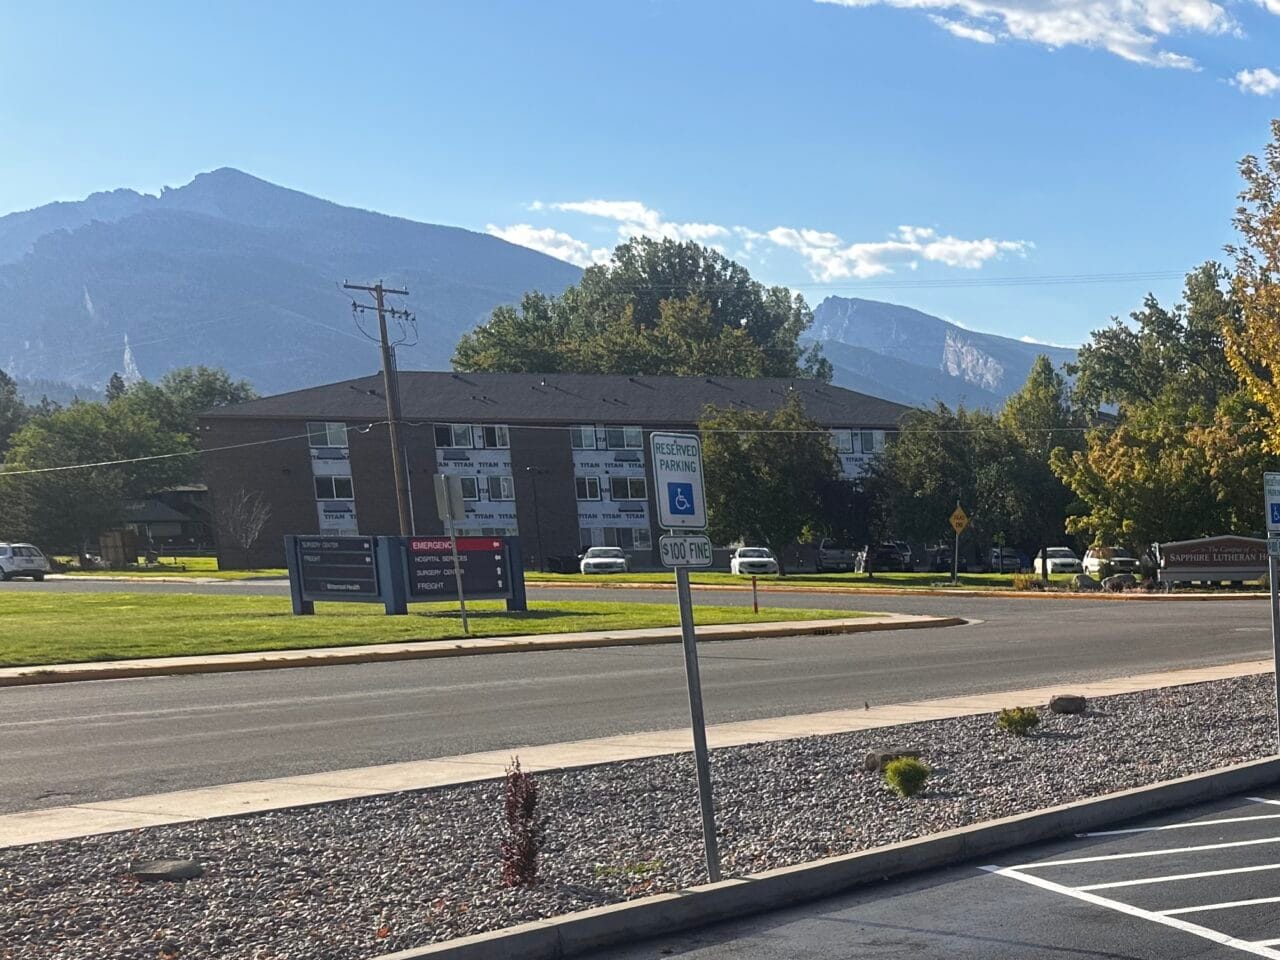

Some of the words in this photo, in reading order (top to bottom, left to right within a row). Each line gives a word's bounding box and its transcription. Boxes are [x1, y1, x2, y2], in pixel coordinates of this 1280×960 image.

[655, 442, 697, 457] RESERVED
[660, 460, 697, 473] PARKING
[412, 541, 457, 550] EMERGENC
[663, 543, 686, 560] $100
[689, 542, 711, 559] FINE
[1169, 553, 1209, 562] SAPPHIRE
[1213, 552, 1257, 561] LUTHERAN
[417, 582, 444, 591] FREIGHT
